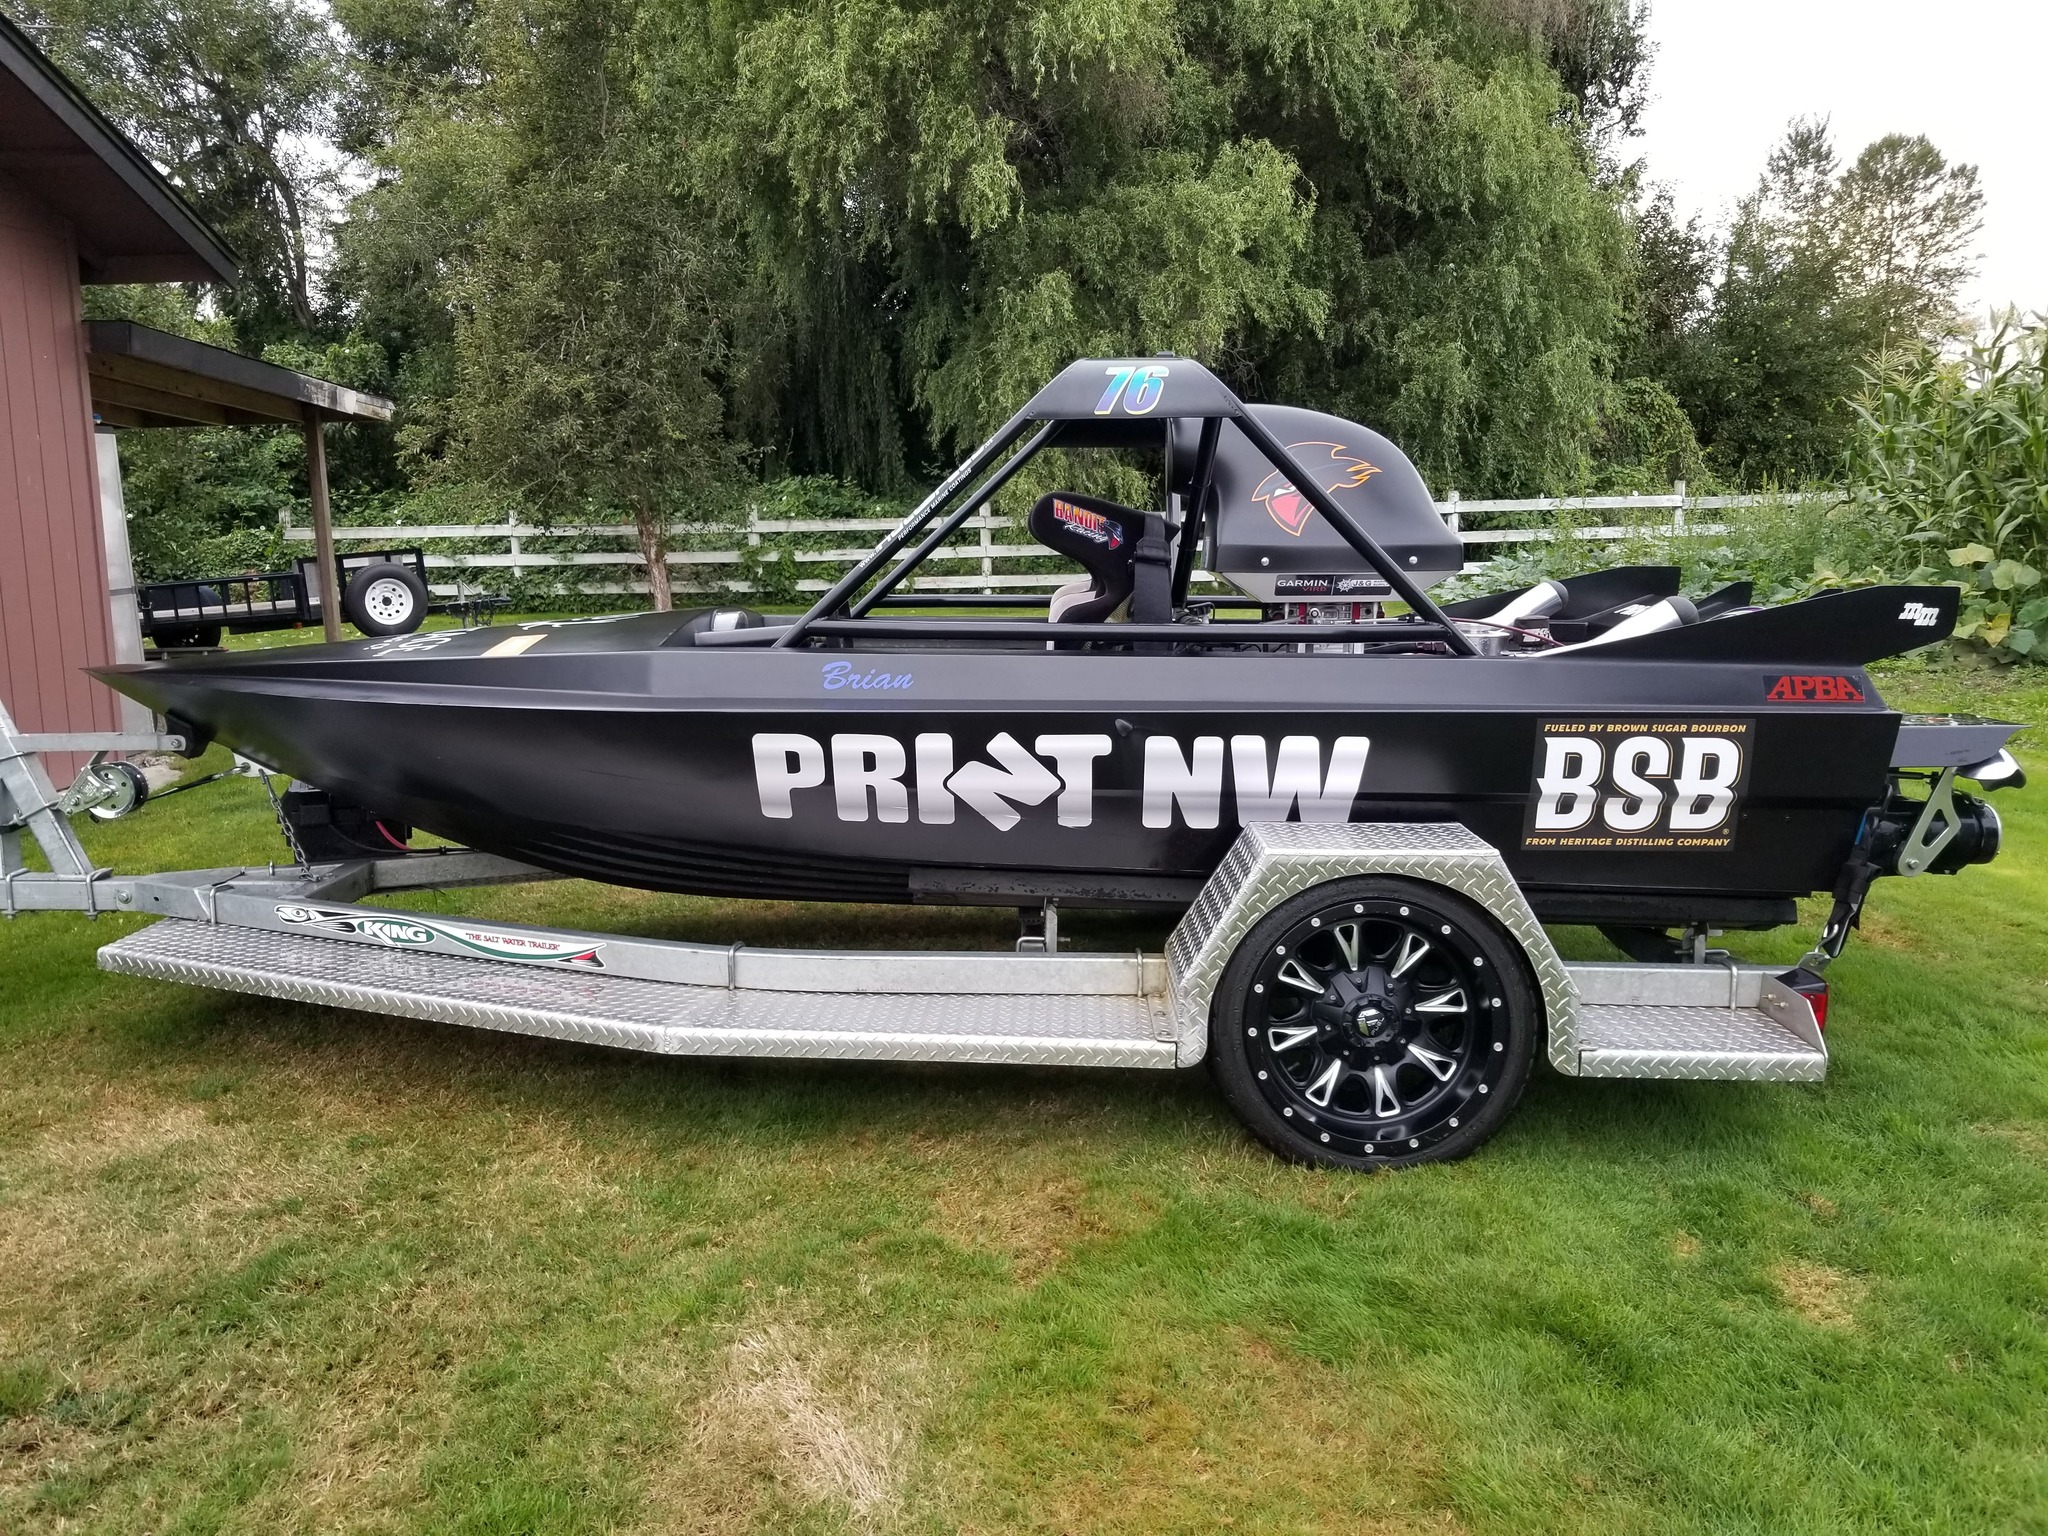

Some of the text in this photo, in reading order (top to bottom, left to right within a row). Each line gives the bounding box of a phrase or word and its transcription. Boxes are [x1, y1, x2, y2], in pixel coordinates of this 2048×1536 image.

[1094, 366, 1170, 415] 76
[897, 467, 972, 541] PERFORMANCE MARINE COATINGS
[1053, 498, 1106, 535] BANDIT
[1277, 579, 1328, 587] GARMIN
[821, 661, 914, 690] Brian
[1767, 676, 1865, 703] APBA
[1544, 724, 1747, 733] FUELED BY BROWN SUGAR BOURBON
[751, 732, 1370, 832] PRINT NW
[1535, 735, 1743, 833] BSB
[1525, 837, 1731, 847] FROM HERITAGE DISTILLING COMPANY
[363, 920, 427, 947] KING
[483, 935, 501, 943] SALT
[502, 937, 527, 947] WATER
